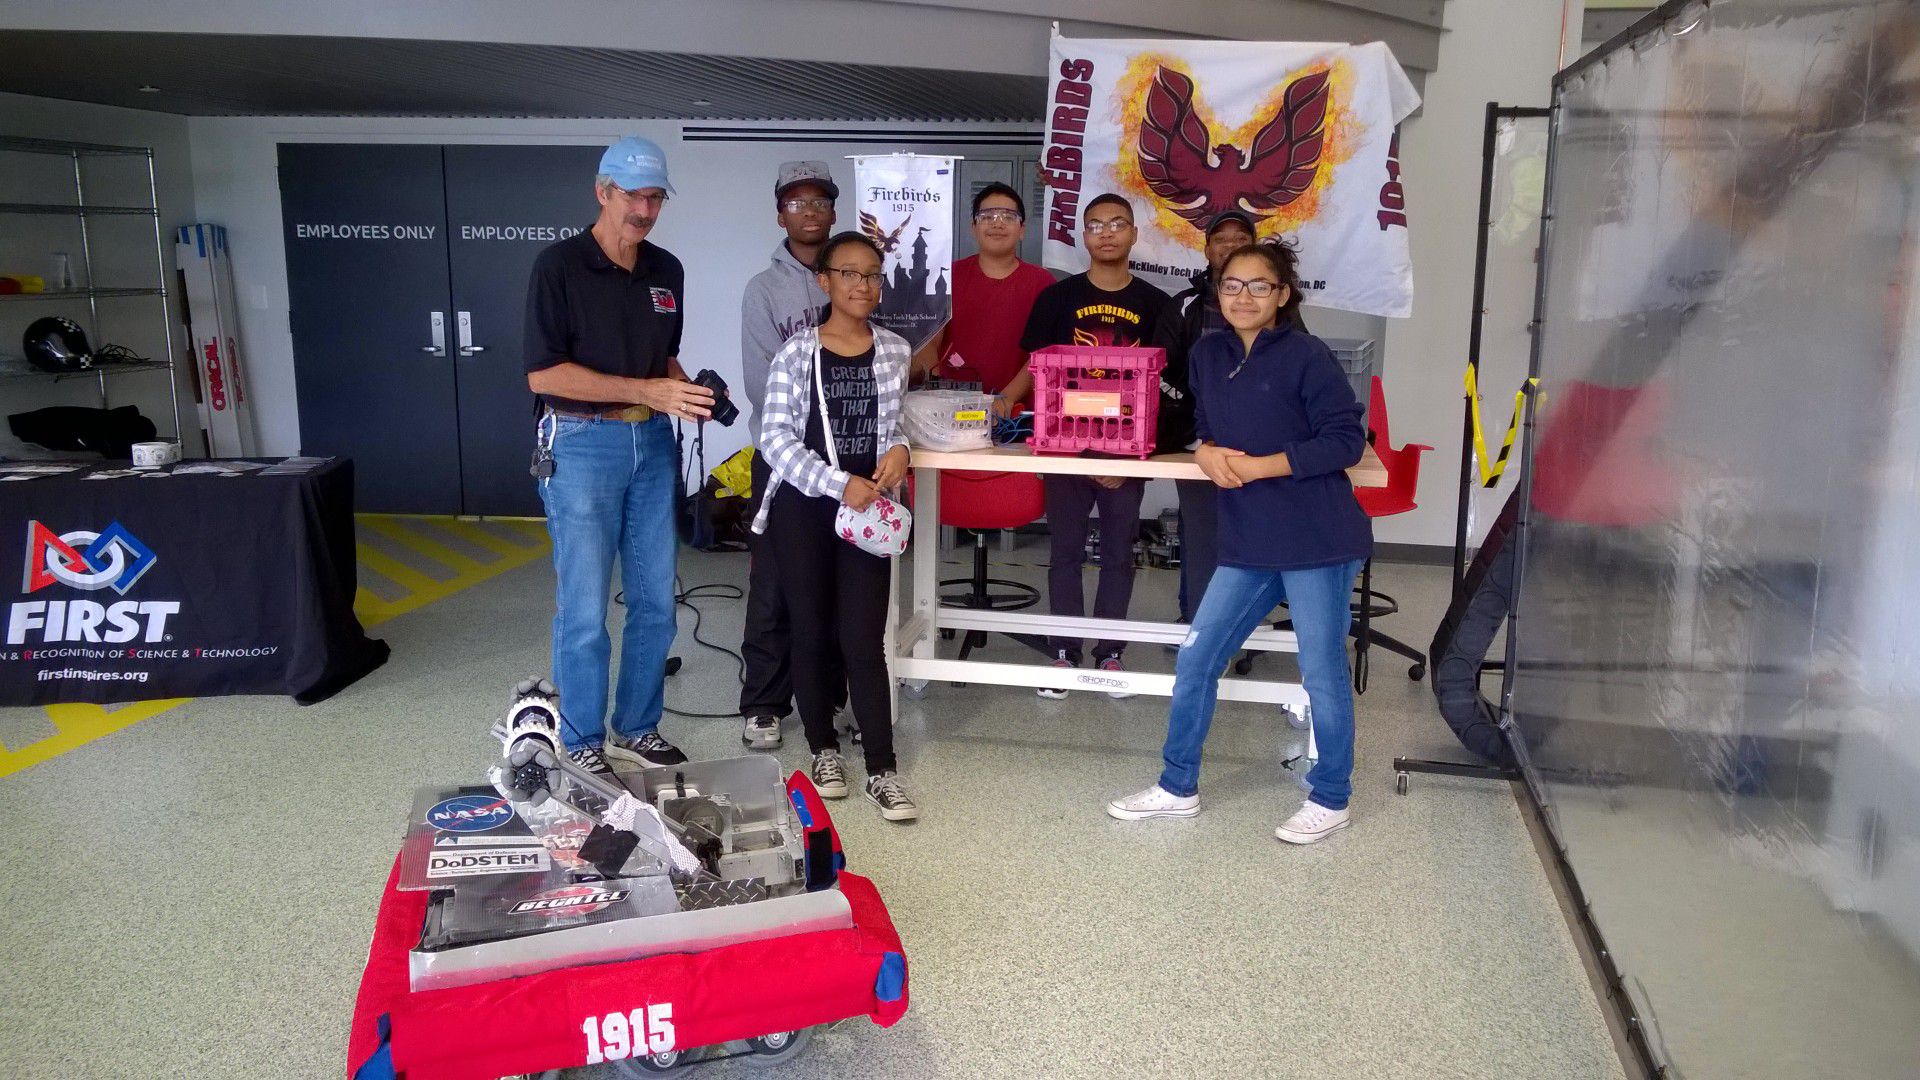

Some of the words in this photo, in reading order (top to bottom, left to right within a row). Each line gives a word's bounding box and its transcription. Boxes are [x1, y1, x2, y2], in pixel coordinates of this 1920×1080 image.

[1044, 58, 1094, 248] FIREBIRDS
[867, 186, 941, 203] Firebirds
[892, 203, 915, 213] 1915
[296, 224, 390, 239] EMPLOYEES
[393, 225, 436, 240] ONLY
[461, 225, 556, 240] EMPLOYEES
[560, 227, 585, 238] ON
[1128, 260, 1169, 275] McKinley
[1170, 265, 1192, 278] Tech
[1313, 280, 1326, 290] DC
[920, 312, 937, 320] School
[1076, 304, 1140, 325] FIREBIRDS
[841, 399, 871, 416] THAT
[830, 418, 848, 436] ILL
[6, 599, 181, 645] FIRST
[10, 652, 19, 660] &
[24, 648, 105, 661] RECOGNITION
[108, 650, 124, 659] OF
[127, 648, 178, 659] SCIENCE
[181, 650, 190, 658] &
[195, 646, 278, 659] TECHNOLOGY
[37, 667, 149, 682] firstinspires.org
[1082, 675, 1105, 684] SHOP
[1106, 678, 1123, 687] FOX
[434, 806, 509, 821] NASA
[430, 853, 539, 870] DoDSTEM
[517, 891, 622, 912] BECHTEL
[582, 1002, 676, 1065] 1915
